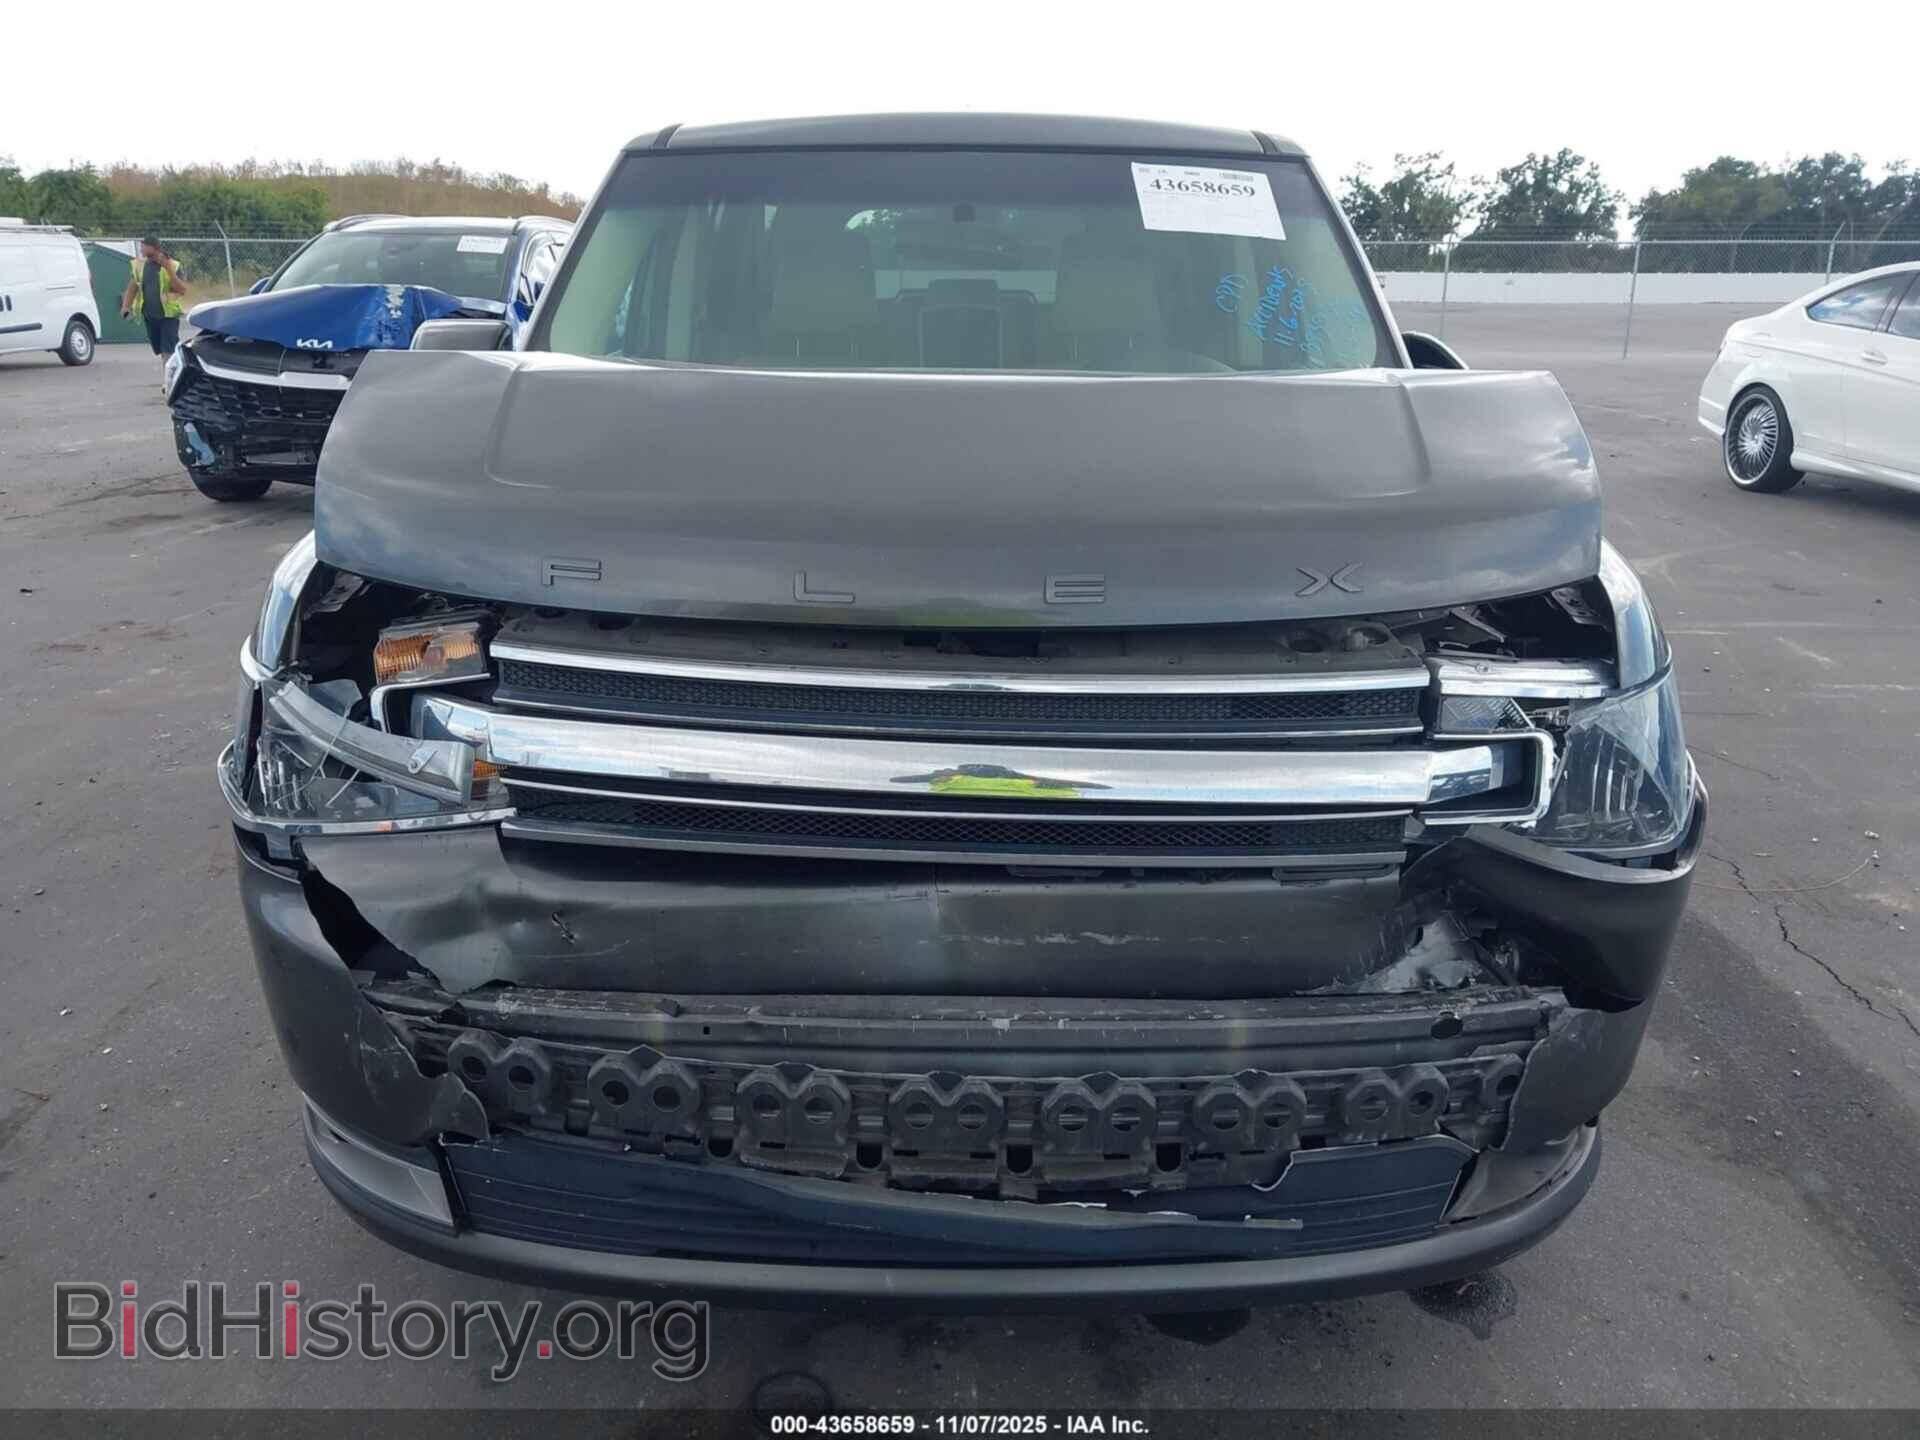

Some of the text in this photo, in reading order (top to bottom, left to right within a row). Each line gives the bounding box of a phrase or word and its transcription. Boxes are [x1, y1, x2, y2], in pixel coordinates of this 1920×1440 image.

[1149, 178, 1256, 198] 43658659
[296, 338, 333, 349] KIA
[542, 557, 1362, 605] FLEX
